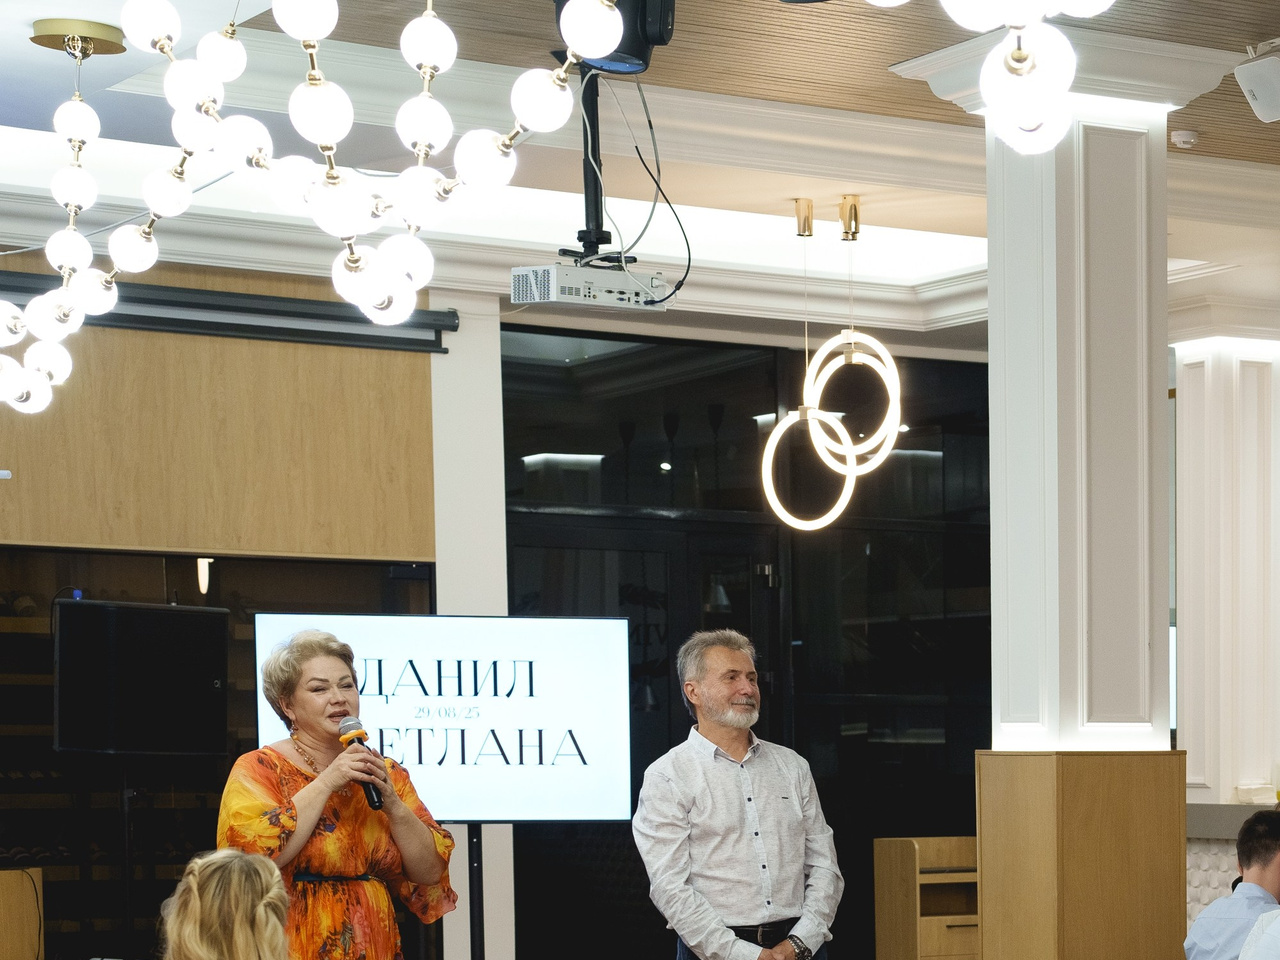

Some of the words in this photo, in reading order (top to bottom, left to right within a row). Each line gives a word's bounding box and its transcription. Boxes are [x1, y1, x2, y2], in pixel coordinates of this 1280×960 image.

[358, 658, 538, 703] ДАНИЛ
[413, 706, 480, 719] 29/08/25
[379, 727, 589, 766] ЕТЛАНА
